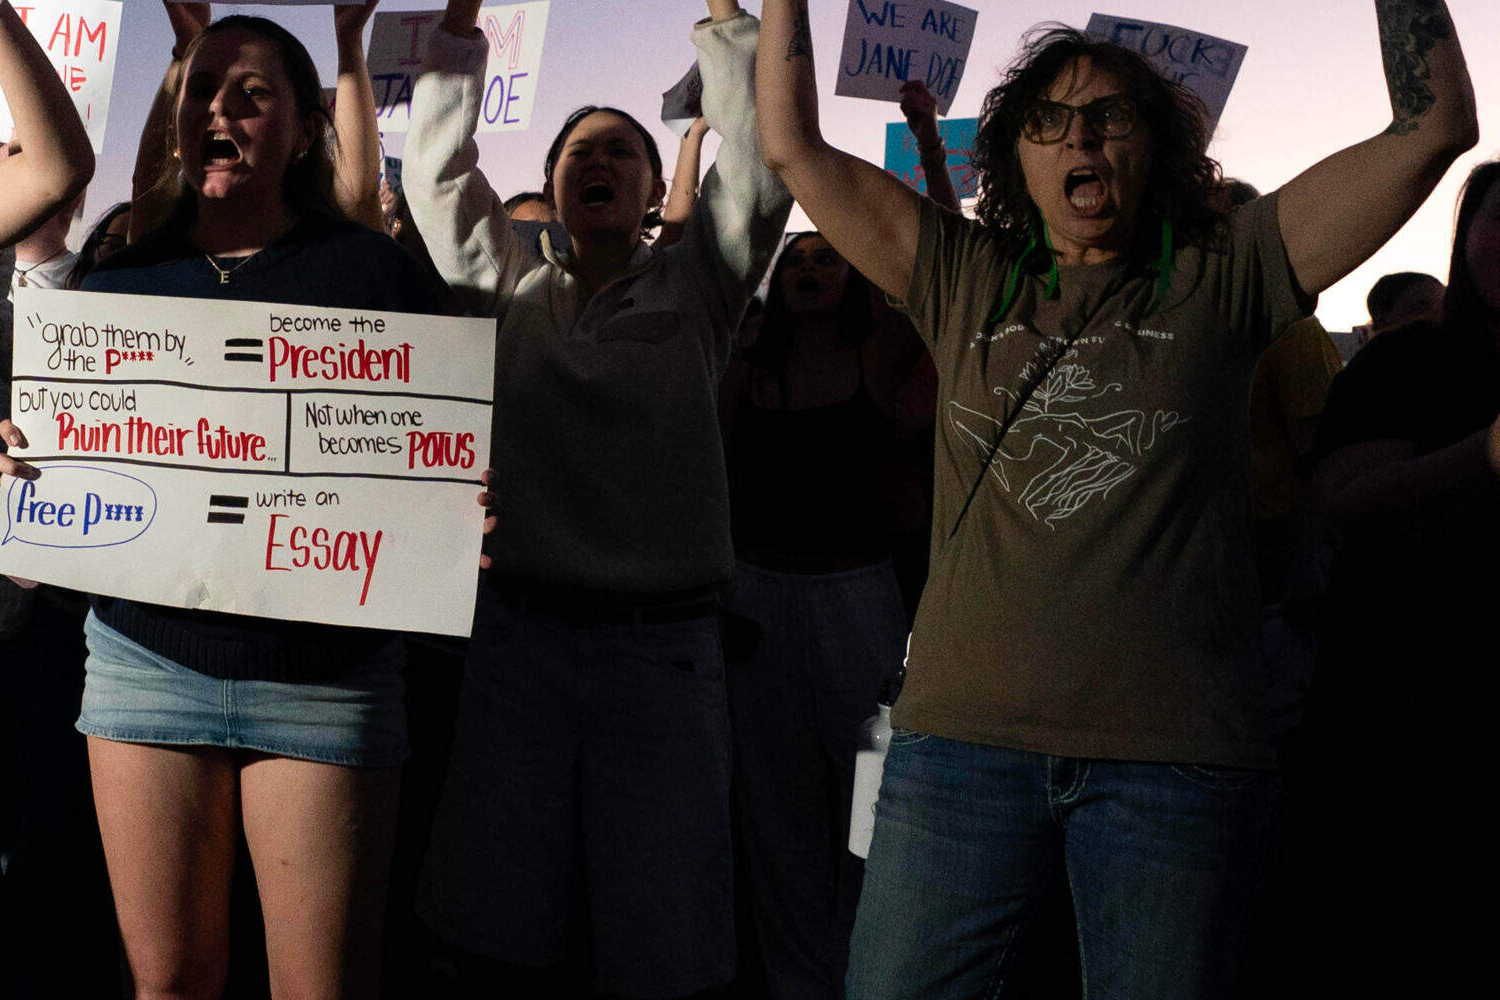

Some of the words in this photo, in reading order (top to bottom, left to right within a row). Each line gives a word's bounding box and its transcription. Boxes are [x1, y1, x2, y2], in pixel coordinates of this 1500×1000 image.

[47, 13, 107, 62] AM
[921, 8, 967, 44] ARE
[101, 323, 161, 351] them
[164, 328, 186, 360] by
[270, 314, 342, 333] become
[348, 316, 386, 333] the
[63, 349, 97, 372] the
[269, 336, 415, 383] President
[19, 387, 48, 413] but
[50, 389, 83, 419] you
[88, 388, 137, 412] could
[306, 402, 333, 429] Not
[336, 404, 387, 426] when
[390, 410, 424, 427] one
[55, 411, 122, 452] Ruin
[122, 416, 194, 456] their
[318, 422, 402, 455] becomes
[405, 430, 476, 470] POTUS
[256, 489, 307, 508] write
[315, 490, 340, 506] an
[265, 513, 383, 607] Essay
